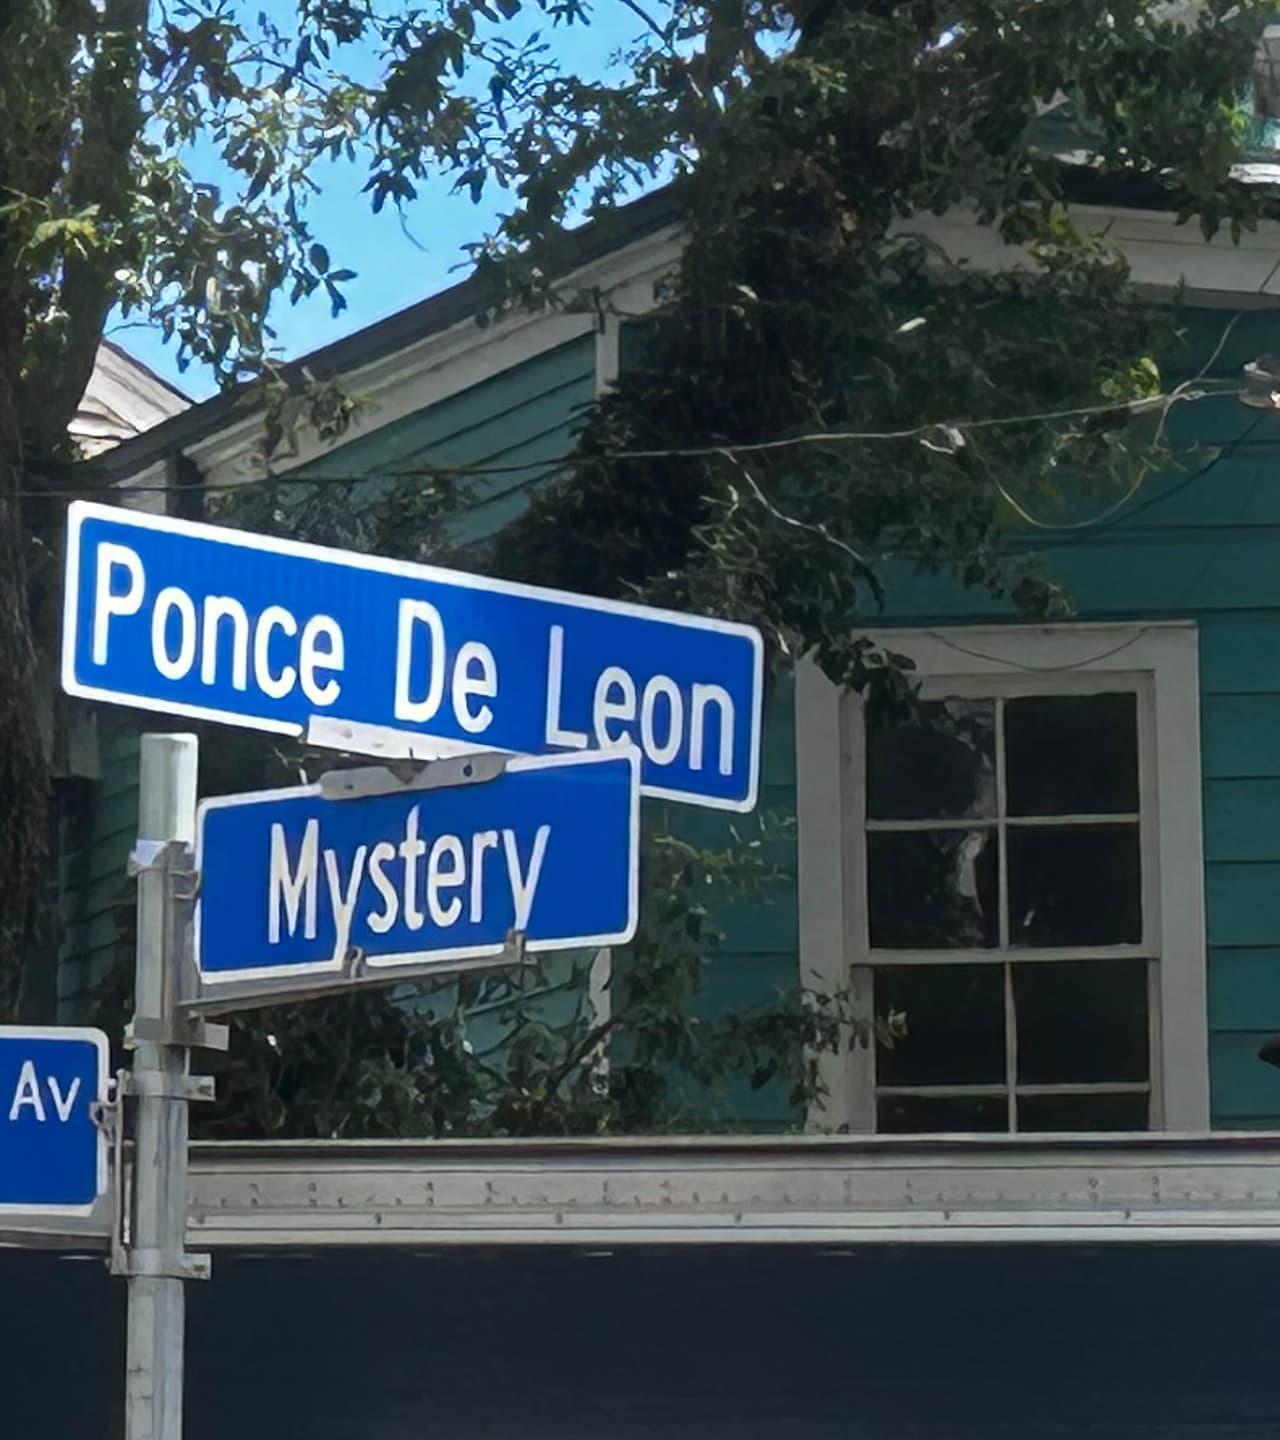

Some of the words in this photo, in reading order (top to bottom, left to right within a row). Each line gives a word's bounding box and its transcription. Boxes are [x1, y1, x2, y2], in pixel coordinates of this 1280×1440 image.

[92, 541, 345, 707] Ponce
[393, 598, 499, 734] De
[546, 624, 735, 777] Leon
[268, 806, 551, 963] Mystery
[8, 1059, 81, 1123] Av
